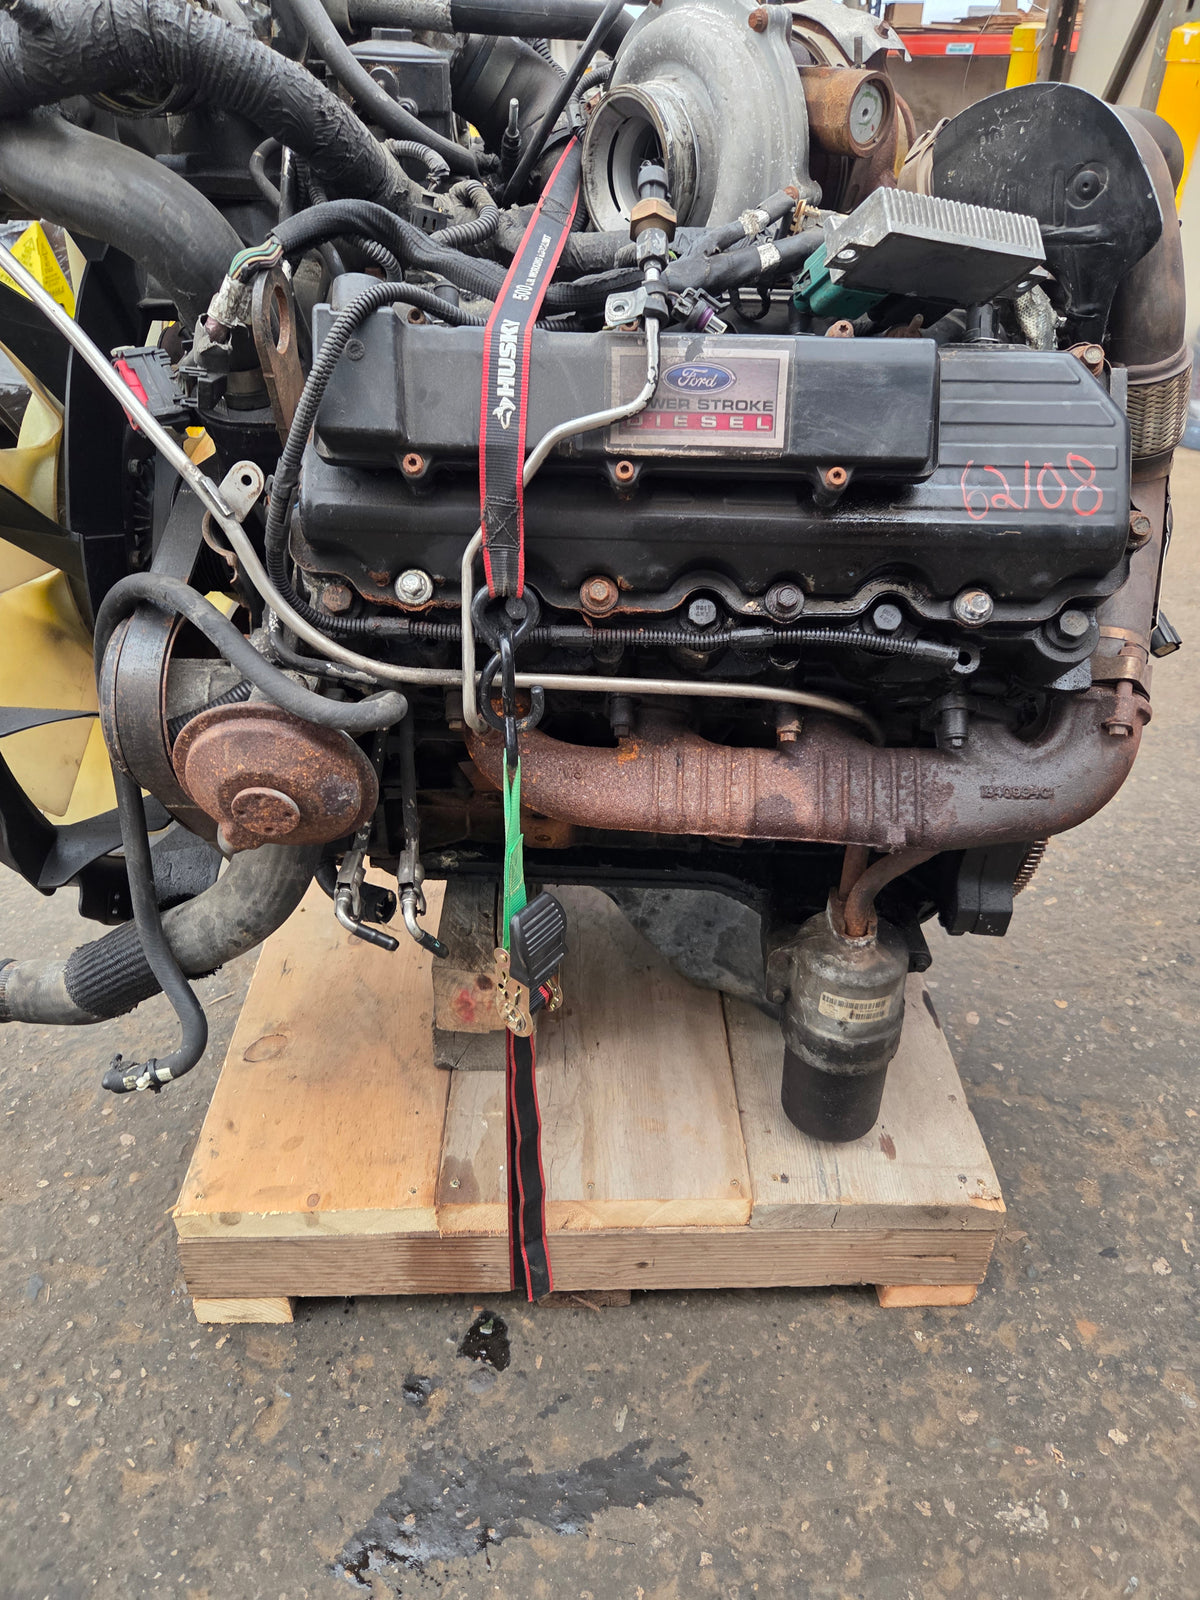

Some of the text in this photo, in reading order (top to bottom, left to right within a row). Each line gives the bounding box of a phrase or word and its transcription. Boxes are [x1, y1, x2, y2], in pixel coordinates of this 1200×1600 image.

[512, 284, 533, 300] 500
[496, 319, 520, 398] HUSKY
[677, 367, 718, 388] Ford
[697, 399, 774, 412] STROKE
[960, 452, 1104, 521] 62108
